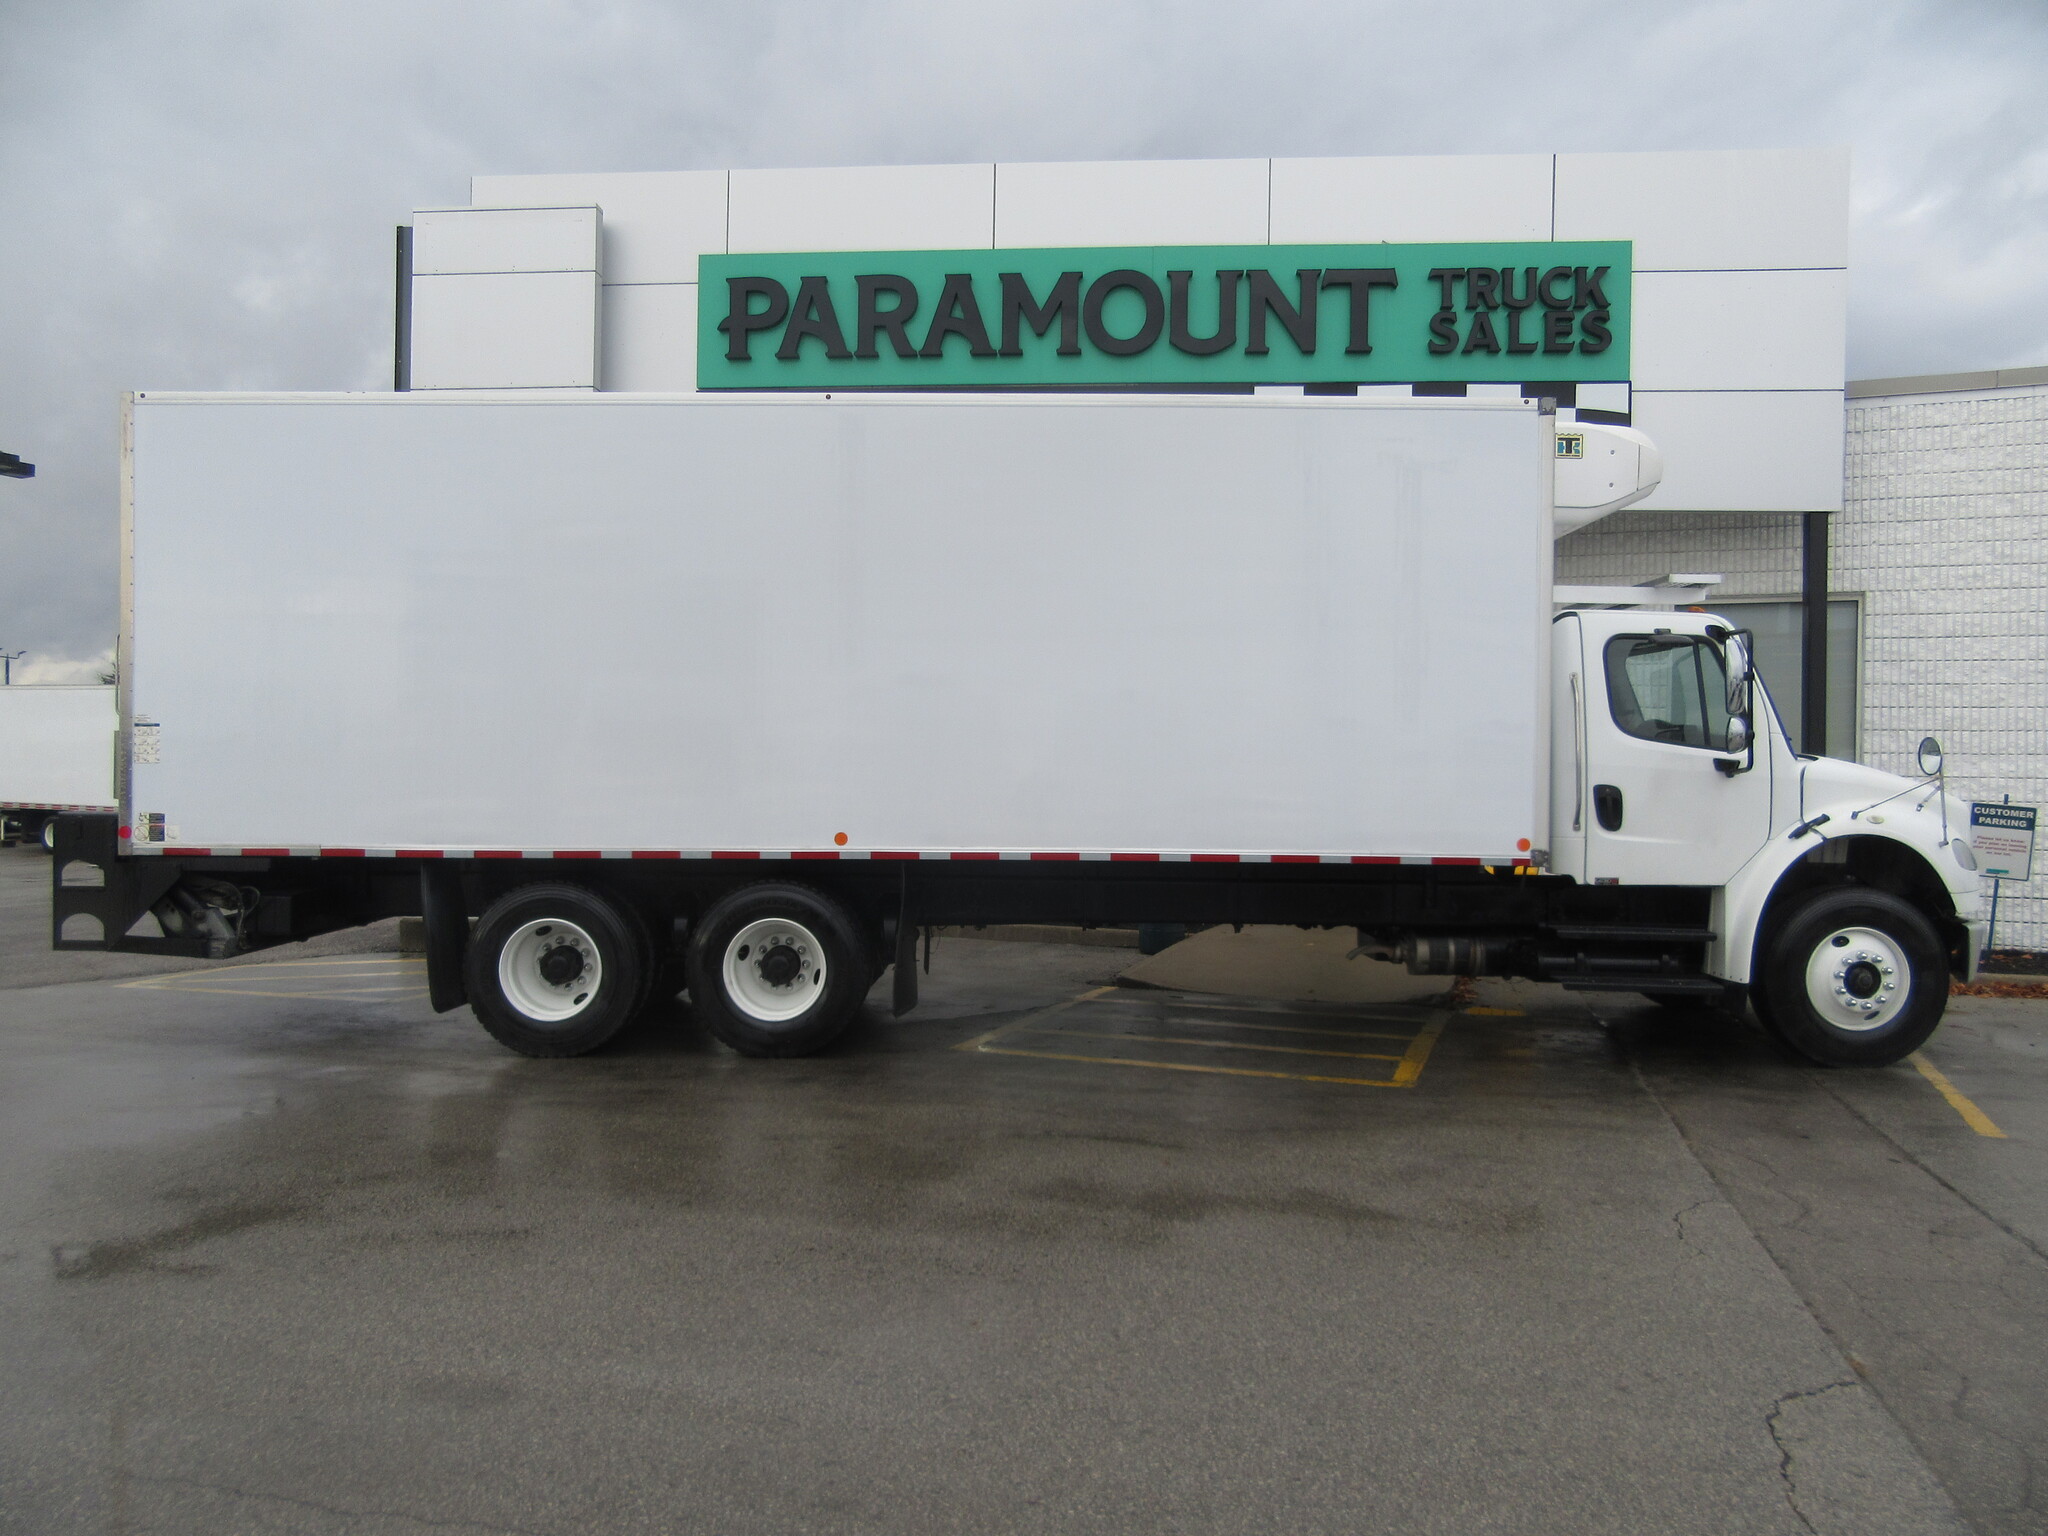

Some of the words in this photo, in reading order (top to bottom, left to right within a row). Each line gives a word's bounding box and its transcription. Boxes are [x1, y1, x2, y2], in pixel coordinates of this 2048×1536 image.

[1427, 266, 1612, 311] TRUCK
[717, 269, 1398, 361] PARAMOUNT
[1428, 310, 1613, 355] SALES
[1974, 807, 2034, 818] CUSTOMER
[1978, 816, 2027, 827] PARKING
